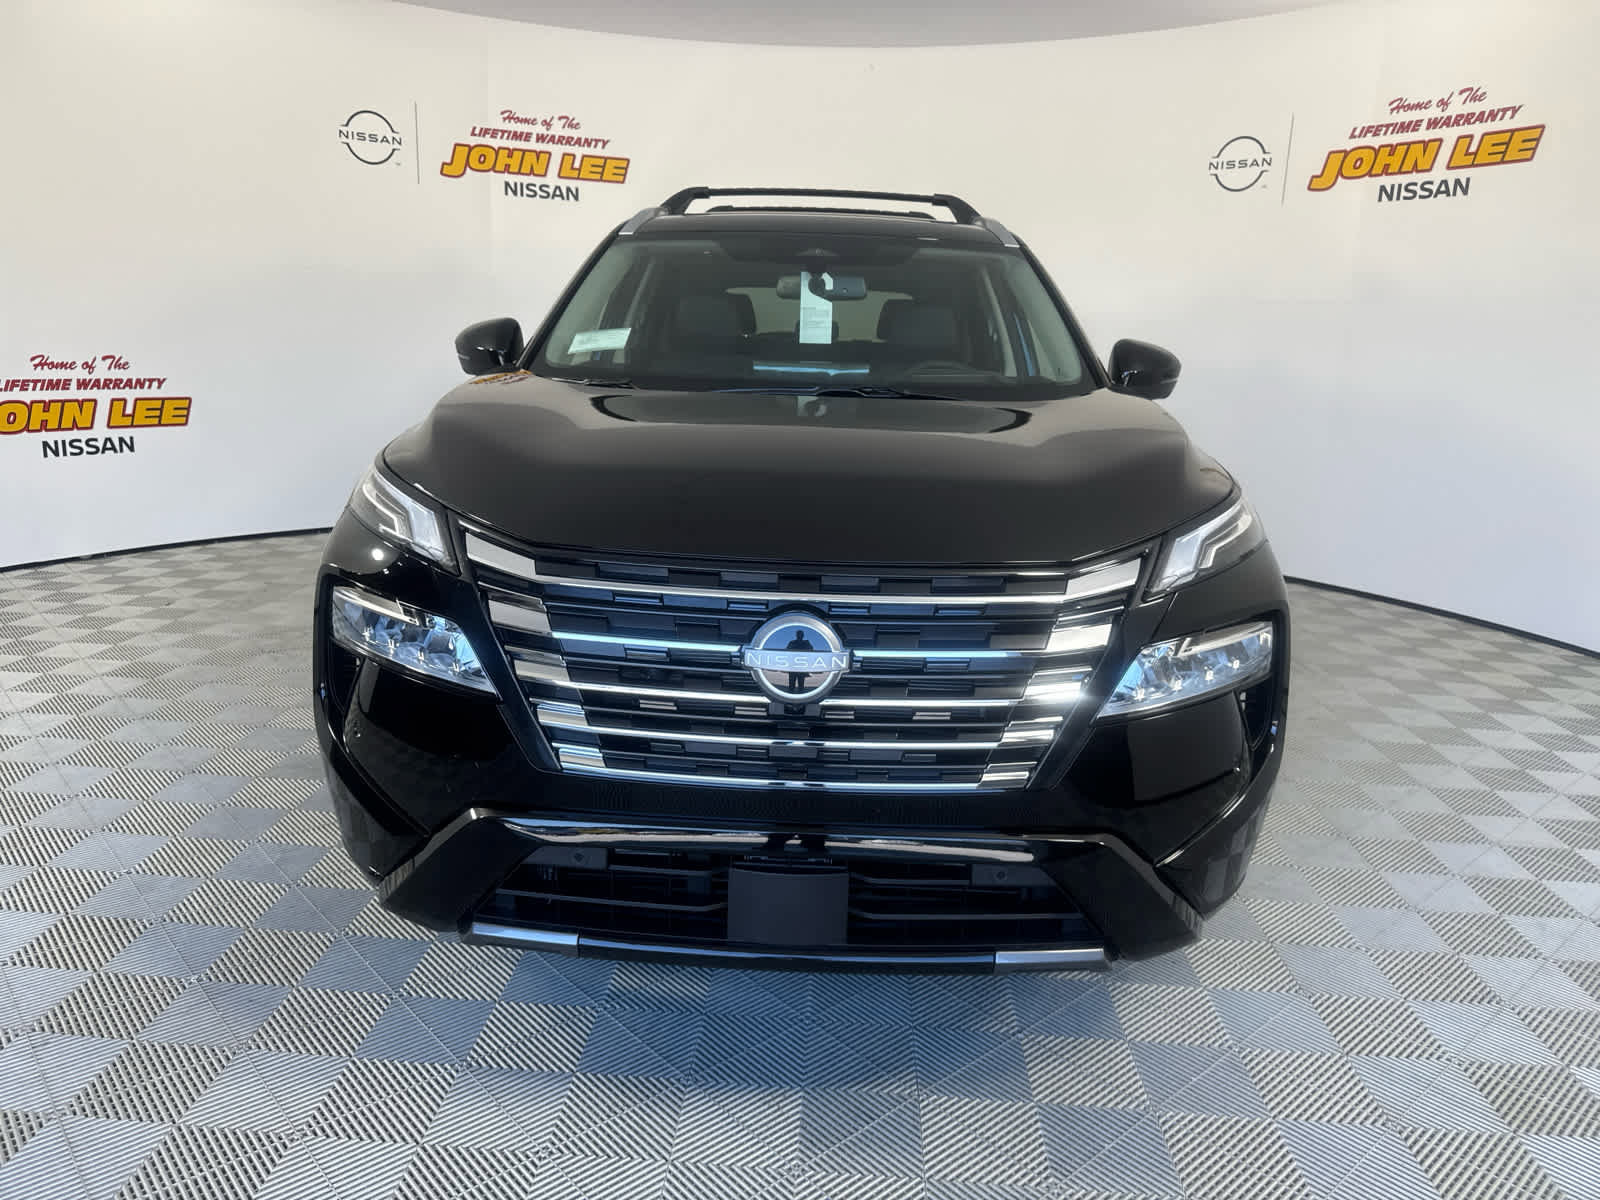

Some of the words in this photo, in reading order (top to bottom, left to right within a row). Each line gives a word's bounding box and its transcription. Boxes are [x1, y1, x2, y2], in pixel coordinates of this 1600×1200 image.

[1388, 95, 1432, 115] Home
[1436, 92, 1454, 111] of
[1457, 86, 1488, 103] The
[500, 110, 538, 126] Home
[541, 114, 555, 131] of
[557, 115, 582, 131] The
[1349, 117, 1424, 140] LIFETIME
[1426, 104, 1523, 131] WARRANTY
[338, 128, 402, 146] NISSAN
[470, 126, 532, 142] LIFETIME
[535, 133, 609, 149] WARRANTY
[440, 143, 551, 178] JOHN
[557, 153, 630, 183] LEE
[1208, 156, 1272, 171] NISSAN
[1307, 138, 1443, 191] JOHN
[1446, 124, 1545, 169] LEE
[503, 180, 580, 202] NISSAN
[1377, 177, 1471, 202] NISSAN
[30, 354, 77, 371] Home
[81, 357, 96, 375] of
[101, 355, 130, 370] The
[76, 377, 167, 391] WARRANTY
[0, 398, 97, 435] OHN
[107, 396, 192, 429] LEE
[42, 436, 135, 458] NISSAN
[747, 653, 846, 668] NISSAN
